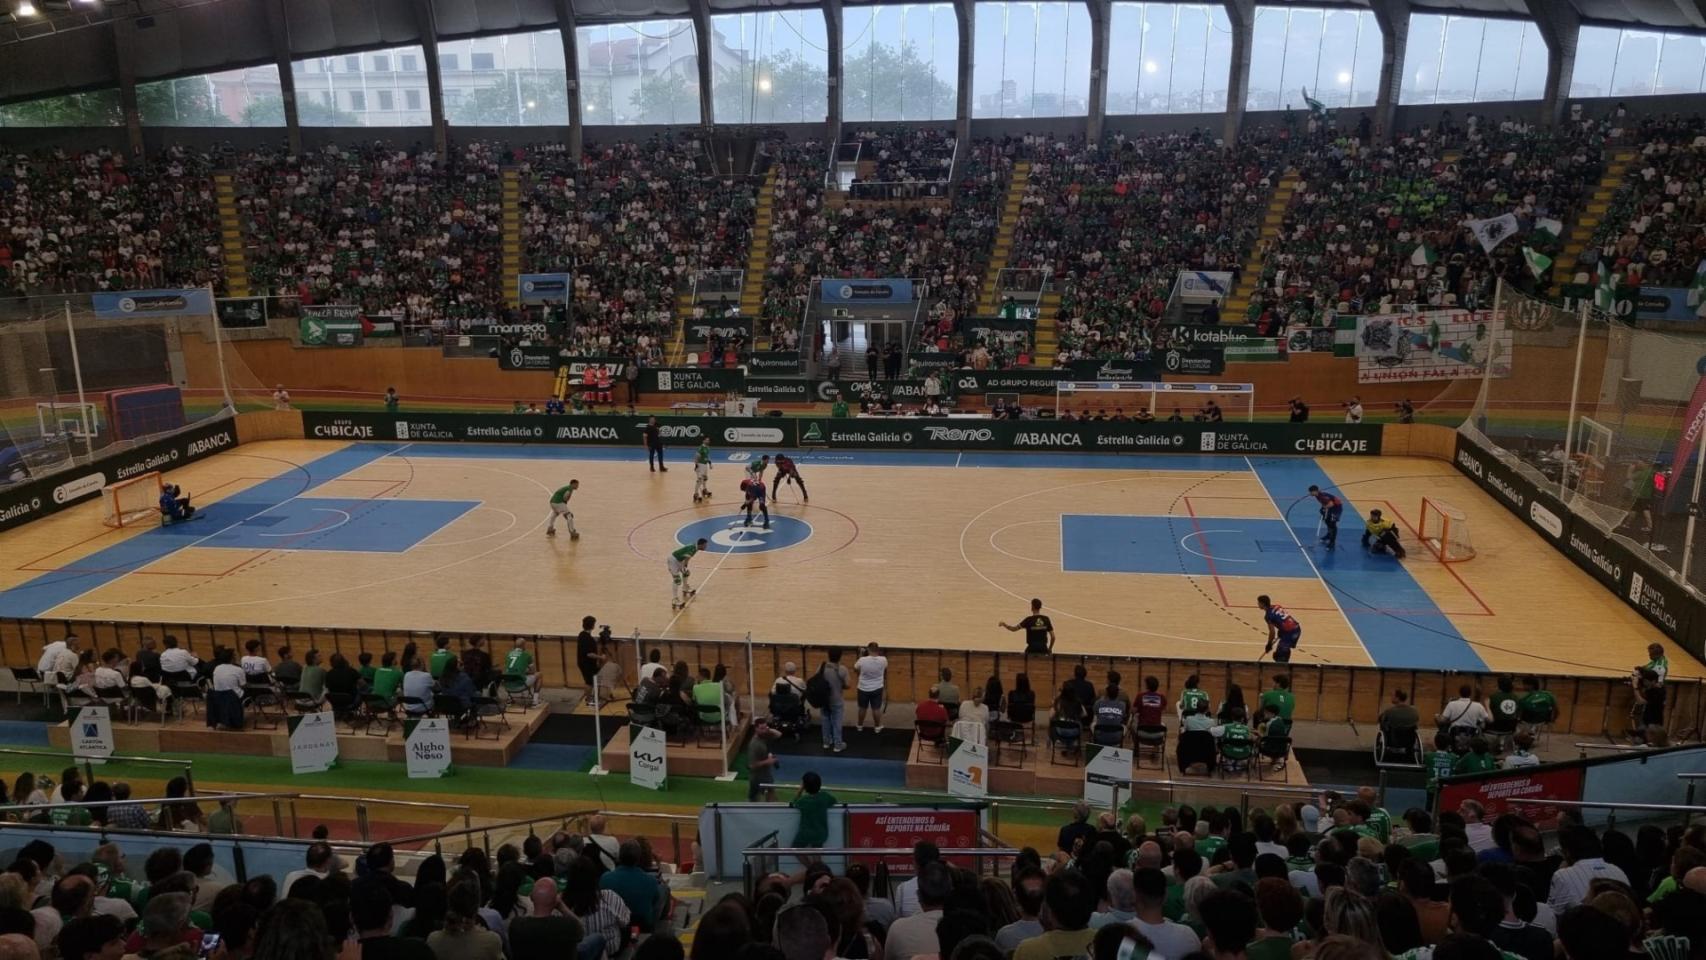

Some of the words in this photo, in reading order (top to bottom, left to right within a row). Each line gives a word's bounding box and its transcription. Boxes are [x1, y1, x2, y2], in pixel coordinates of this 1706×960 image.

[673, 372, 703, 380] XUNTA
[673, 381, 686, 389] DE
[686, 381, 721, 389] GALICIA
[1000, 379, 1029, 387] GRUPO
[410, 423, 437, 431] XUNTA
[467, 426, 500, 437] Estrella
[501, 426, 532, 437] Galicia
[410, 430, 418, 438] DE
[418, 430, 454, 439] GALICIA
[831, 431, 867, 442] Estrella
[868, 431, 901, 443] Galicia
[1218, 433, 1249, 441] XUNTA
[1097, 434, 1134, 446] Estrella
[1135, 434, 1170, 447] Galicia
[1217, 441, 1230, 450] DE
[1231, 441, 1268, 450] GALICIA
[116, 463, 145, 479] Estrella
[145, 453, 170, 470] Galicia
[0, 503, 30, 522] Galicia
[1570, 533, 1591, 559] Estrella
[1591, 548, 1613, 576] Galicia
[1643, 582, 1665, 608] XUNTA
[1641, 595, 1650, 610] DE
[1650, 603, 1677, 631] GALICIA
[509, 656, 518, 669] 7
[412, 742, 445, 753] Algho
[415, 752, 443, 760] Noso
[875, 815, 888, 825] ASÍ
[887, 816, 929, 824] ENTENDEMOS
[885, 824, 914, 833] DEPORTE
[924, 823, 951, 832] CORUÑA
